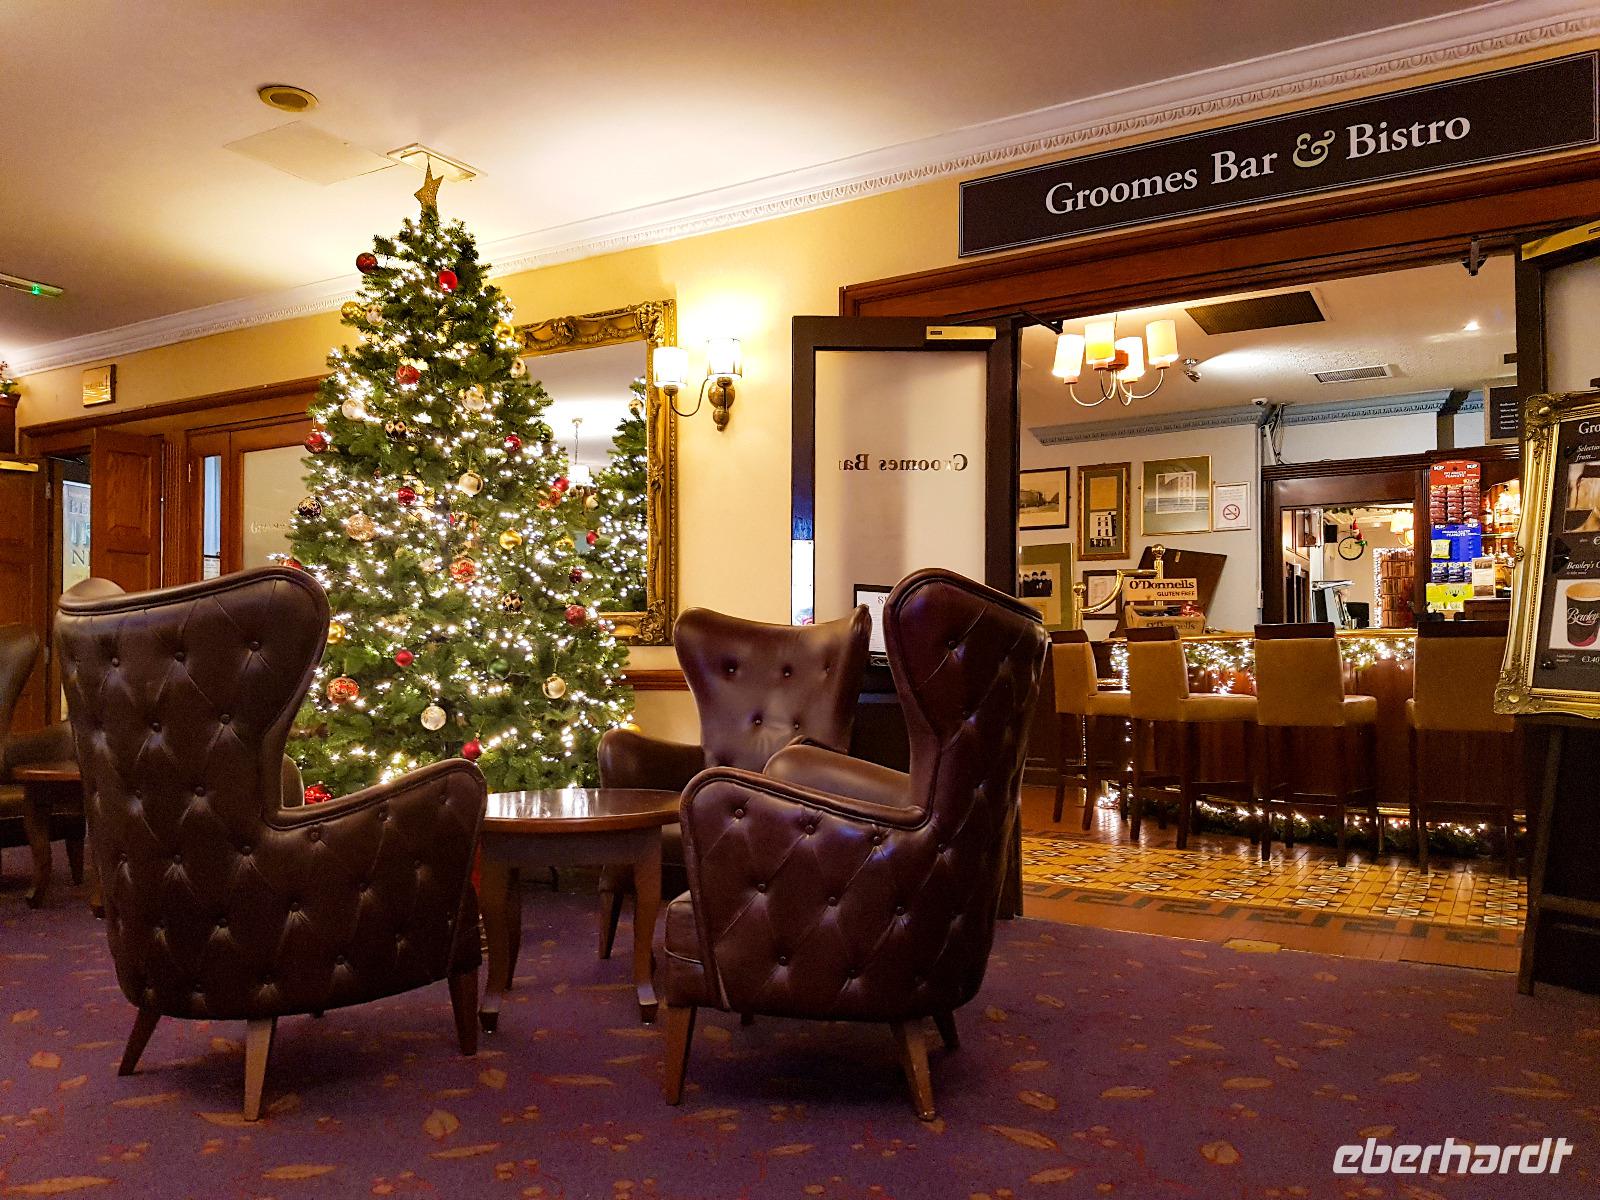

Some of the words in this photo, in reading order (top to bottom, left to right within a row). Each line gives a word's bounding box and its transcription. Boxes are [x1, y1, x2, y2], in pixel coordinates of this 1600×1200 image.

[1045, 166, 1199, 215] Groomes
[1210, 149, 1279, 185] Bar
[1292, 129, 1336, 168] &
[1345, 115, 1471, 160] Bistro
[1129, 580, 1195, 589] O'Donnells
[1147, 621, 1195, 630] O'Dnells
